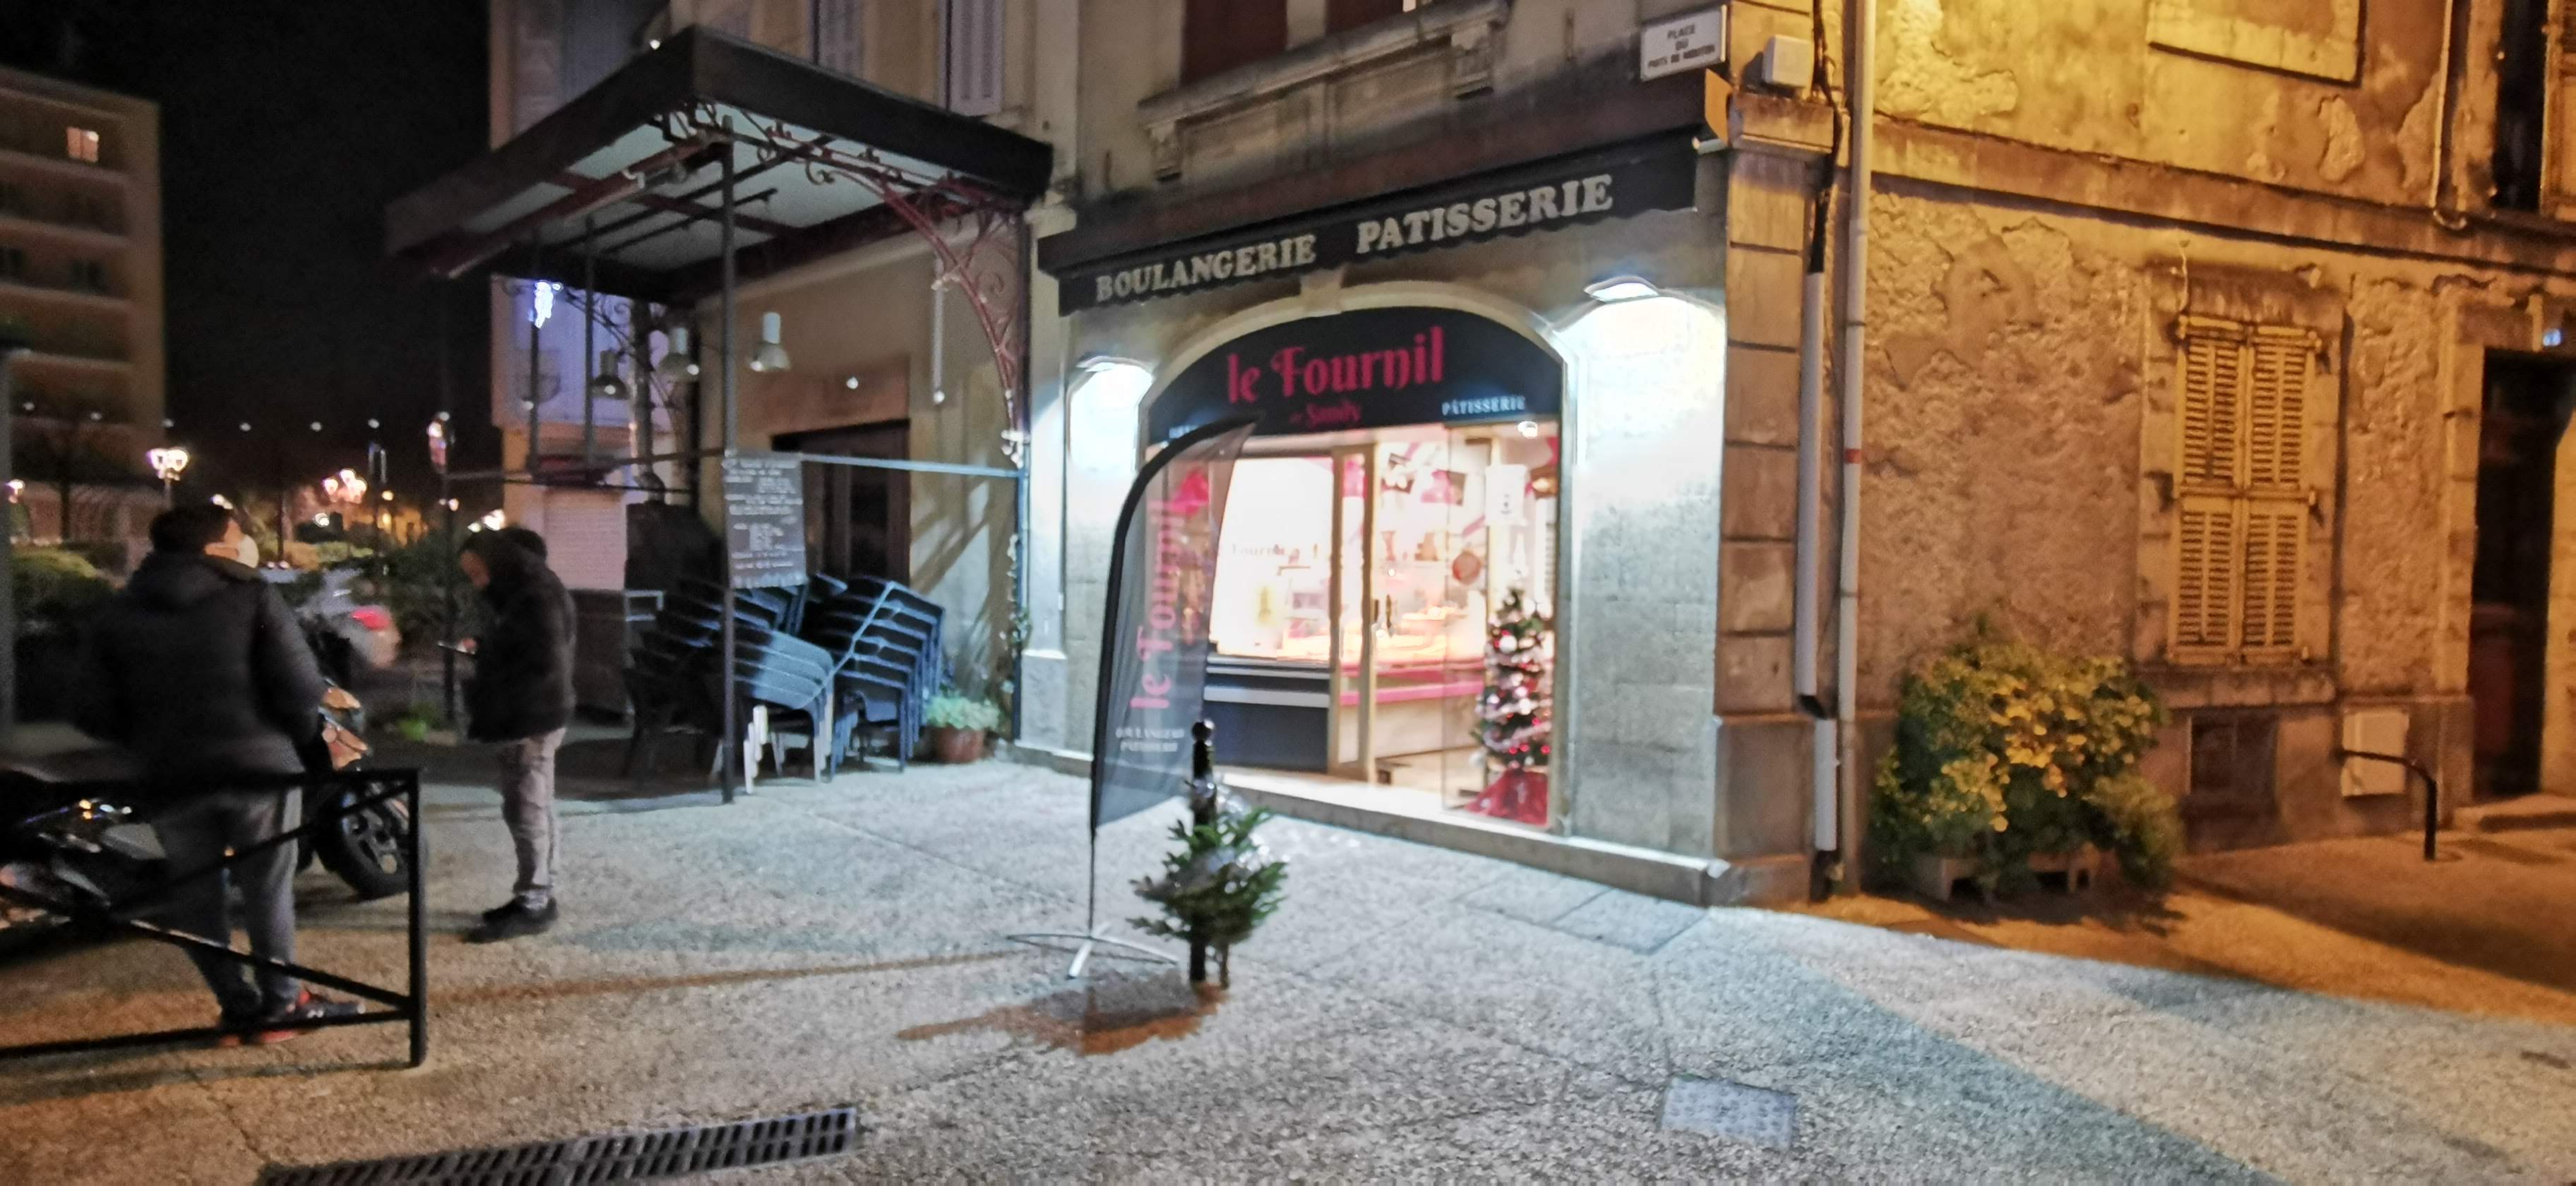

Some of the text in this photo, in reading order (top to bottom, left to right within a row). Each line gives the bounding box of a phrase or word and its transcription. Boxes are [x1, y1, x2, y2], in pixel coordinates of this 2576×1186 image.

[1097, 174, 1613, 303] BOULANGERIE PATISSERIE
[1228, 325, 1444, 403] le Fournil
[1130, 673, 1172, 709] le
